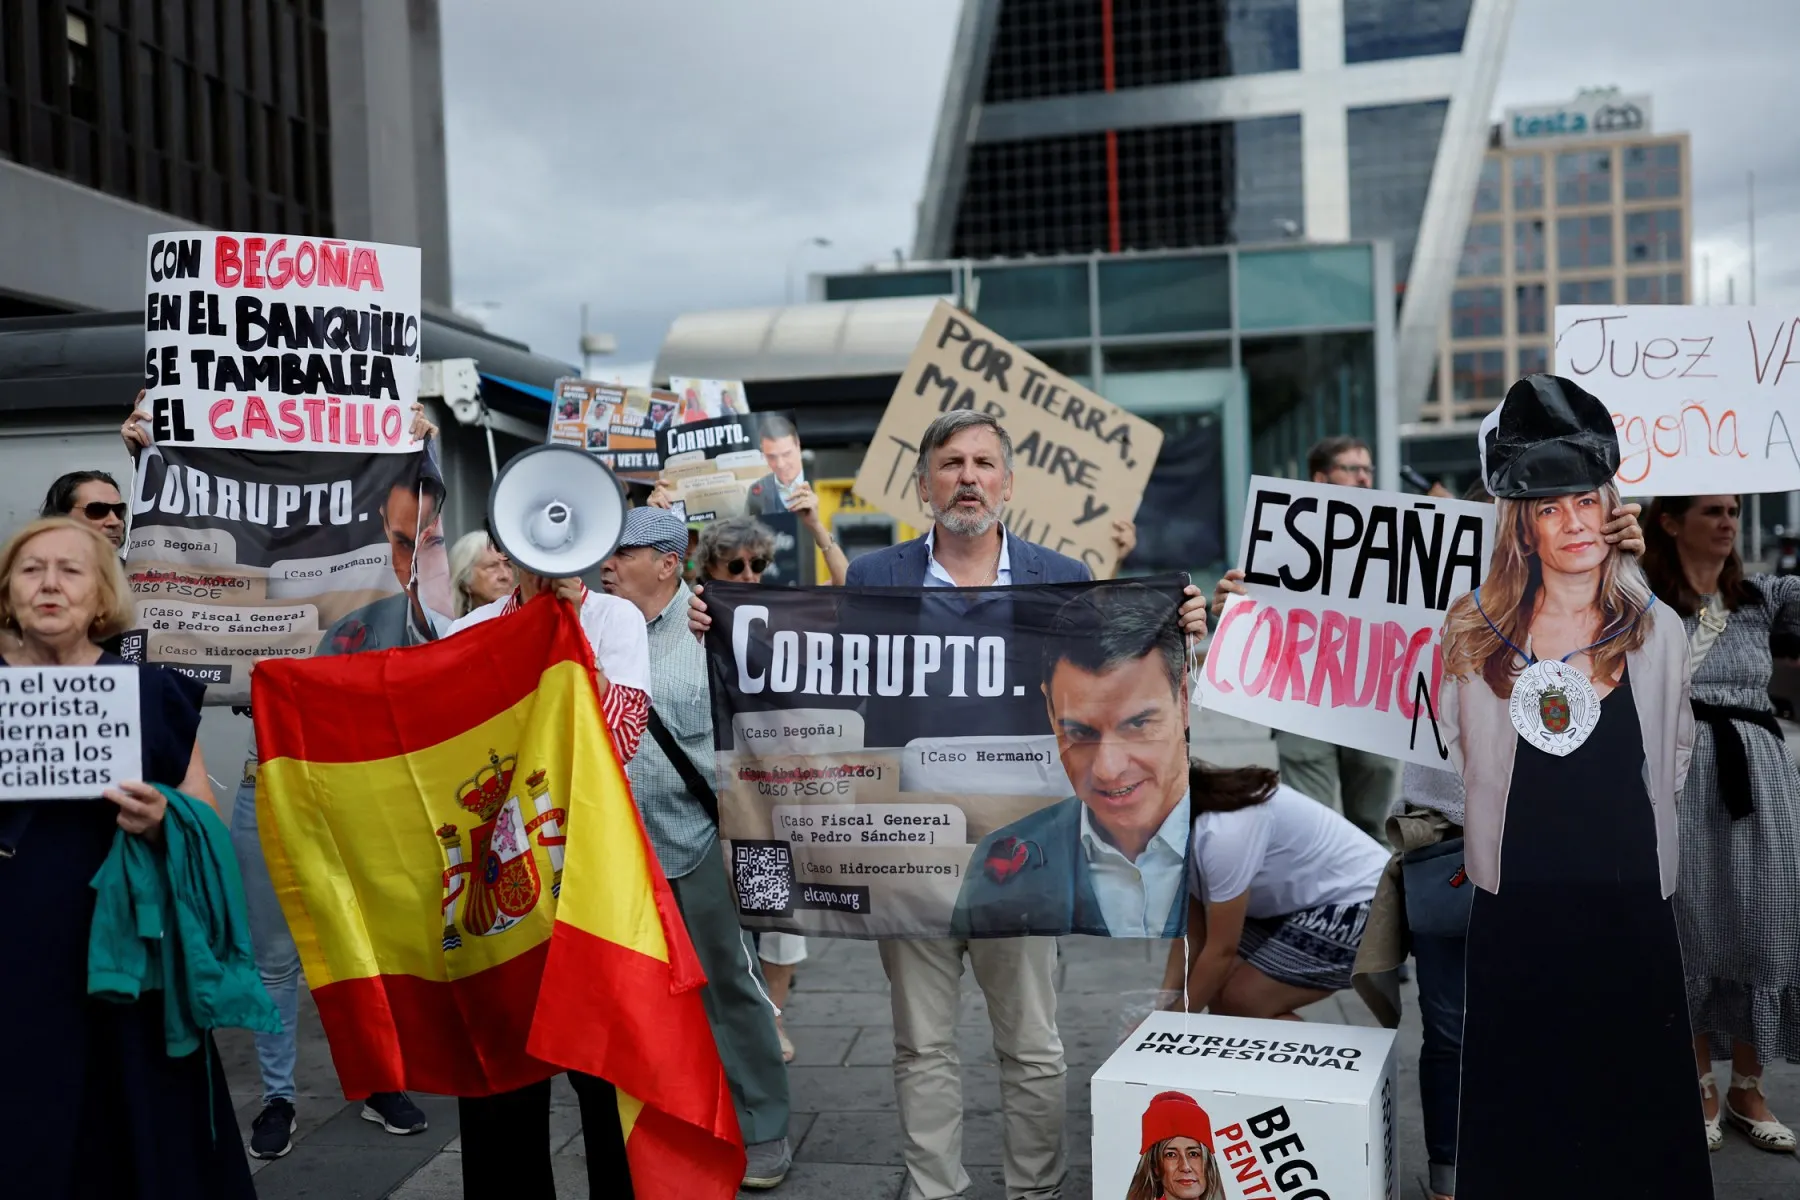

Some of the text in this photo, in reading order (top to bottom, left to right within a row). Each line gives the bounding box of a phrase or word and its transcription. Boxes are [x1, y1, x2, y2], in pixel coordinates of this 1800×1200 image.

[150, 236, 384, 292] CON BEGOÑA
[147, 293, 181, 331] EN
[188, 290, 227, 336] EL
[937, 316, 1013, 393] POR
[1556, 315, 1718, 379] Juez
[145, 346, 400, 400] SE TAMBALEA
[153, 398, 194, 442] EL
[617, 453, 643, 467] VETE
[1014, 429, 1102, 490] AIRE
[164, 539, 218, 553] Begoña]
[1244, 490, 1483, 610] ESPAÑA
[284, 554, 388, 580] [Caso Hermano]
[166, 582, 222, 599] PSOE
[143, 607, 306, 623] [Caso Fiscal General
[153, 620, 292, 633] de Pedro Sánchez]
[159, 644, 312, 657] [Caso Hidrocarburos]
[21, 672, 43, 694] el
[53, 673, 115, 693] voto
[98, 721, 129, 738] en
[742, 724, 843, 741] [Caso Begoña]
[75, 741, 112, 761] los
[920, 748, 1052, 767] [Caso Hermano]
[2, 765, 111, 787] cialistas
[793, 781, 850, 796] PSOE
[780, 814, 950, 828] [Caso Fiscal General
[791, 829, 934, 844] de Pedro Sánchez]
[802, 862, 960, 877] [Caso Hidrocarburos]
[804, 887, 860, 910] elcapo.org
[1145, 1031, 1362, 1059] INTRUSISMO
[1135, 1042, 1360, 1071] PROFESIONAL
[1215, 1123, 1277, 1200] PENT
